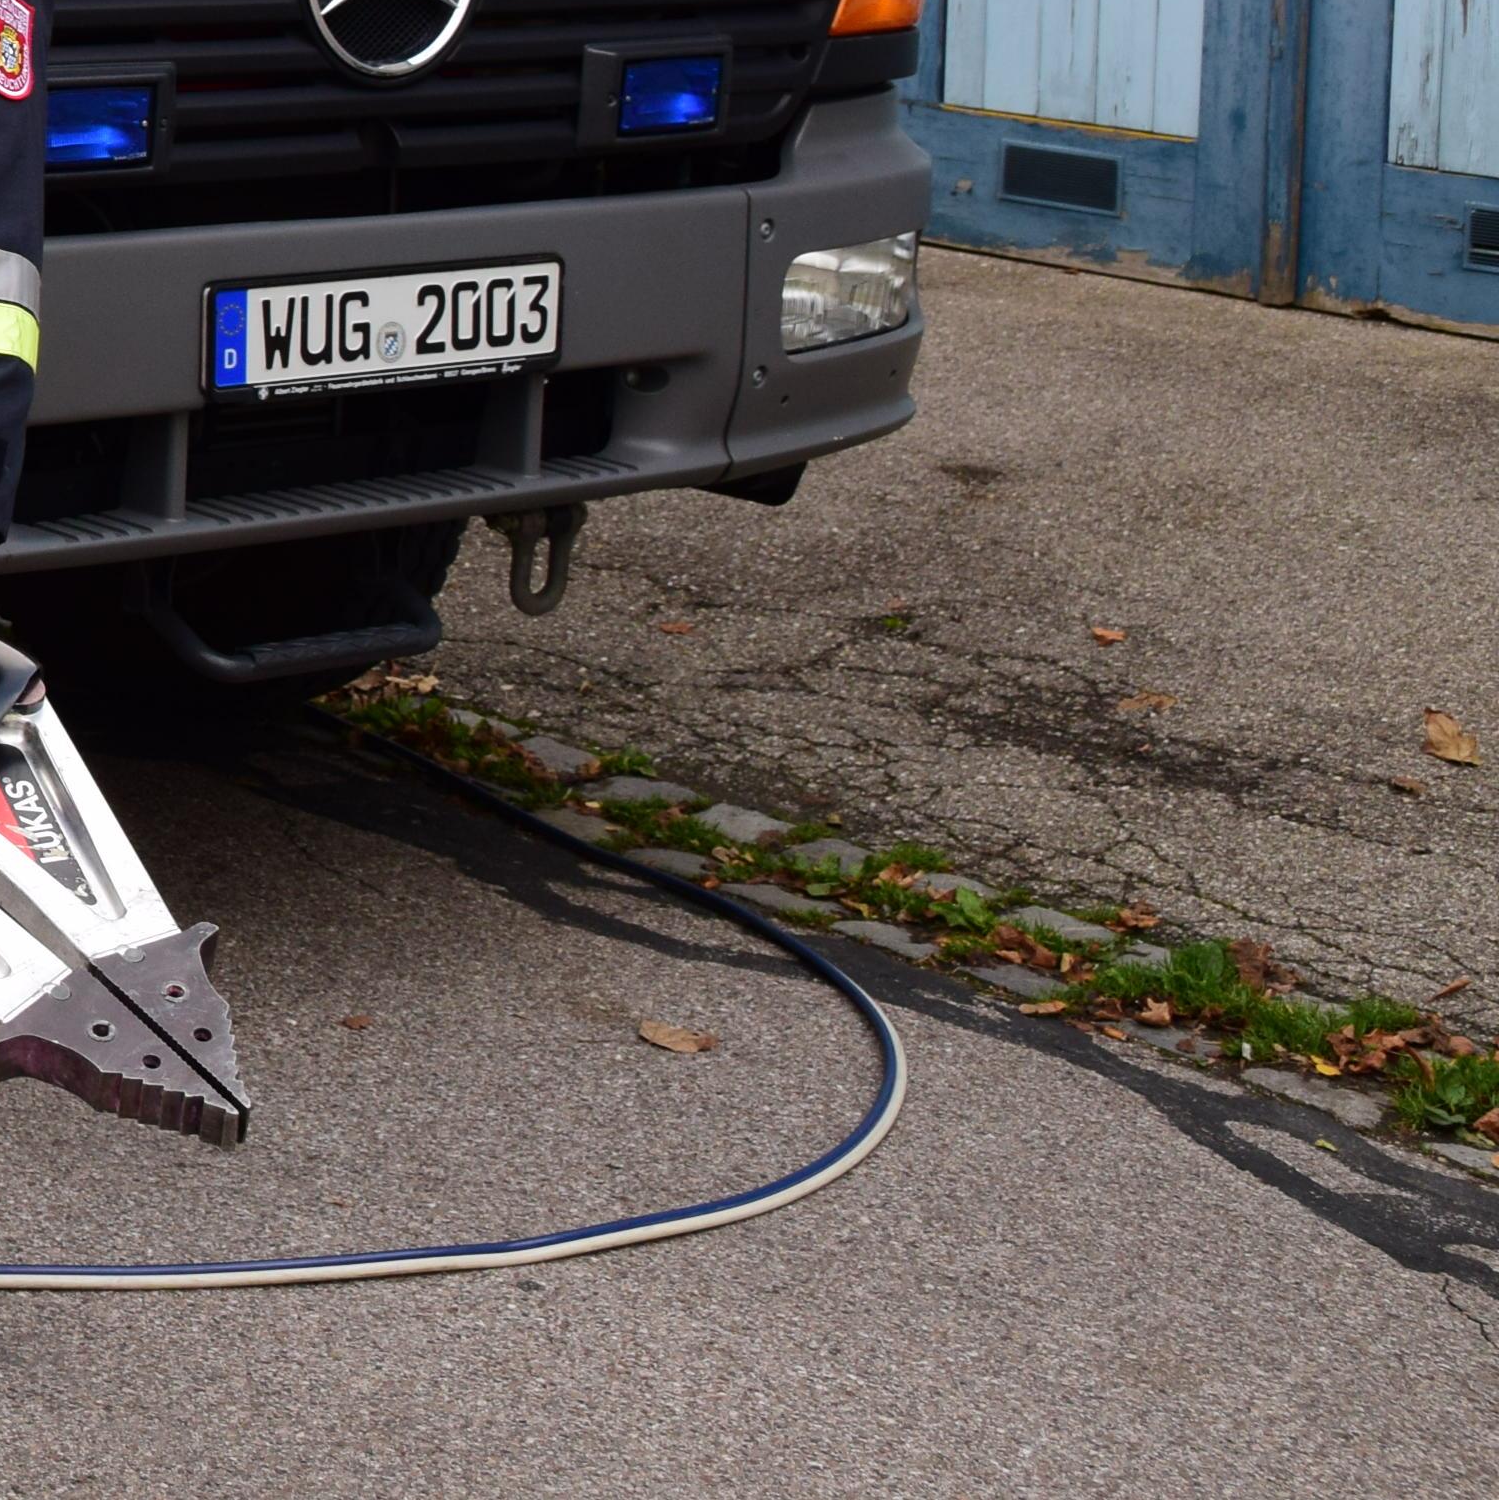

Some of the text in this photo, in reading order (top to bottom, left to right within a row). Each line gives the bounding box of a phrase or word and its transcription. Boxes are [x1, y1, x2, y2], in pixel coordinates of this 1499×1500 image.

[223, 348, 237, 369] D
[261, 274, 551, 371] WUG 2003
[4, 778, 71, 865] LUKAS
